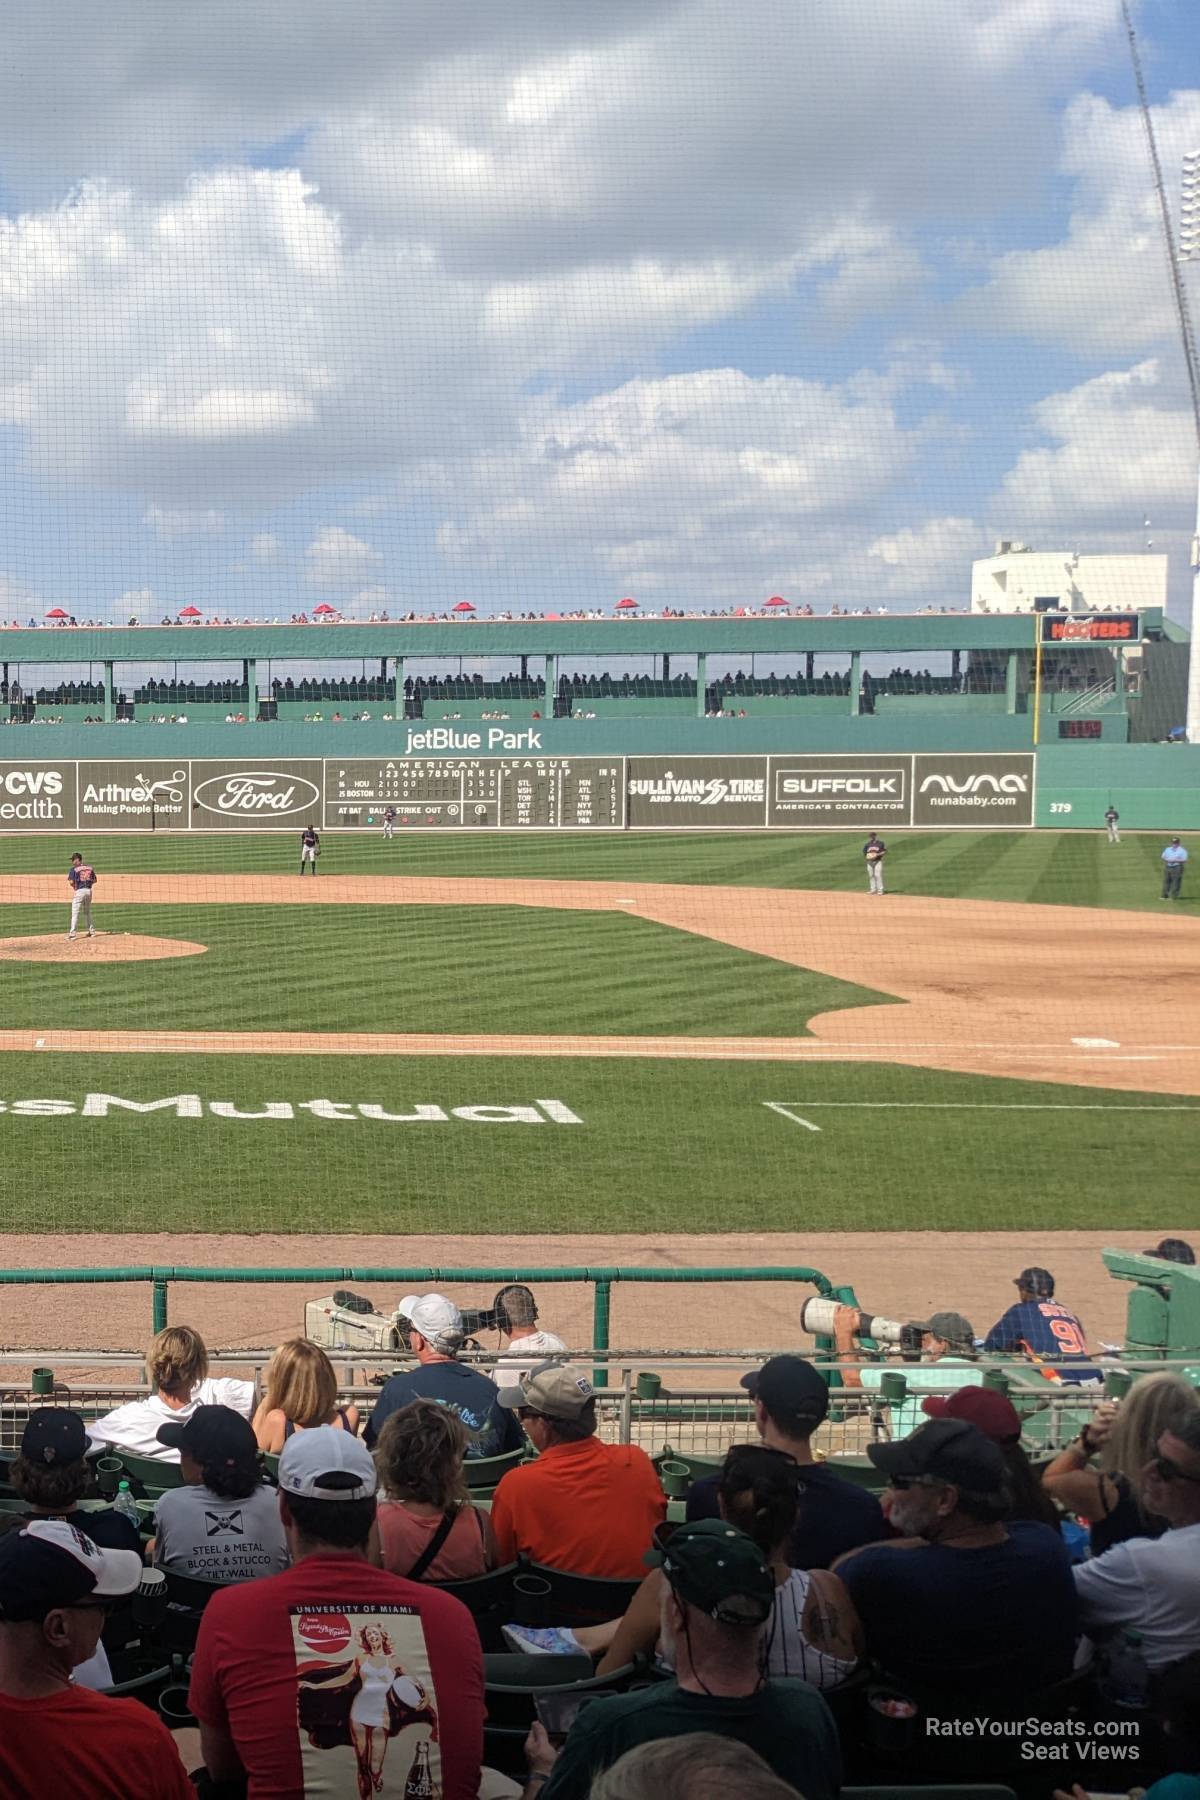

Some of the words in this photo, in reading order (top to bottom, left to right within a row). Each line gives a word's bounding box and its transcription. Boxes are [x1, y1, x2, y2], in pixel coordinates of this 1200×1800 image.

[405, 728, 481, 754] jetBlue
[488, 728, 542, 749] Park
[386, 761, 480, 769] AMERICAN
[501, 760, 569, 768] LEAGUE
[5, 771, 63, 795] CVS
[628, 780, 705, 795] SULLIVAN
[729, 780, 764, 795] TIRE
[783, 779, 896, 793] SUFFOLK
[919, 774, 1027, 793] nuna
[218, 778, 295, 809] Ford
[930, 796, 1016, 807] nunababy.com
[83, 805, 118, 815] Making
[120, 805, 151, 815] People
[153, 805, 182, 813] Better
[1050, 803, 1072, 813] 379
[193, 1546, 221, 1555] STEEL
[224, 1544, 230, 1553] &
[234, 1543, 264, 1552] METAL
[188, 1558, 221, 1569] BLOCK
[223, 1557, 229, 1566] &
[232, 1556, 271, 1566] STUCCO
[206, 1569, 256, 1579] TILT-WALL
[296, 1605, 358, 1613] UNIVERSITY
[363, 1605, 375, 1613] OF
[380, 1605, 412, 1614] MIAMI
